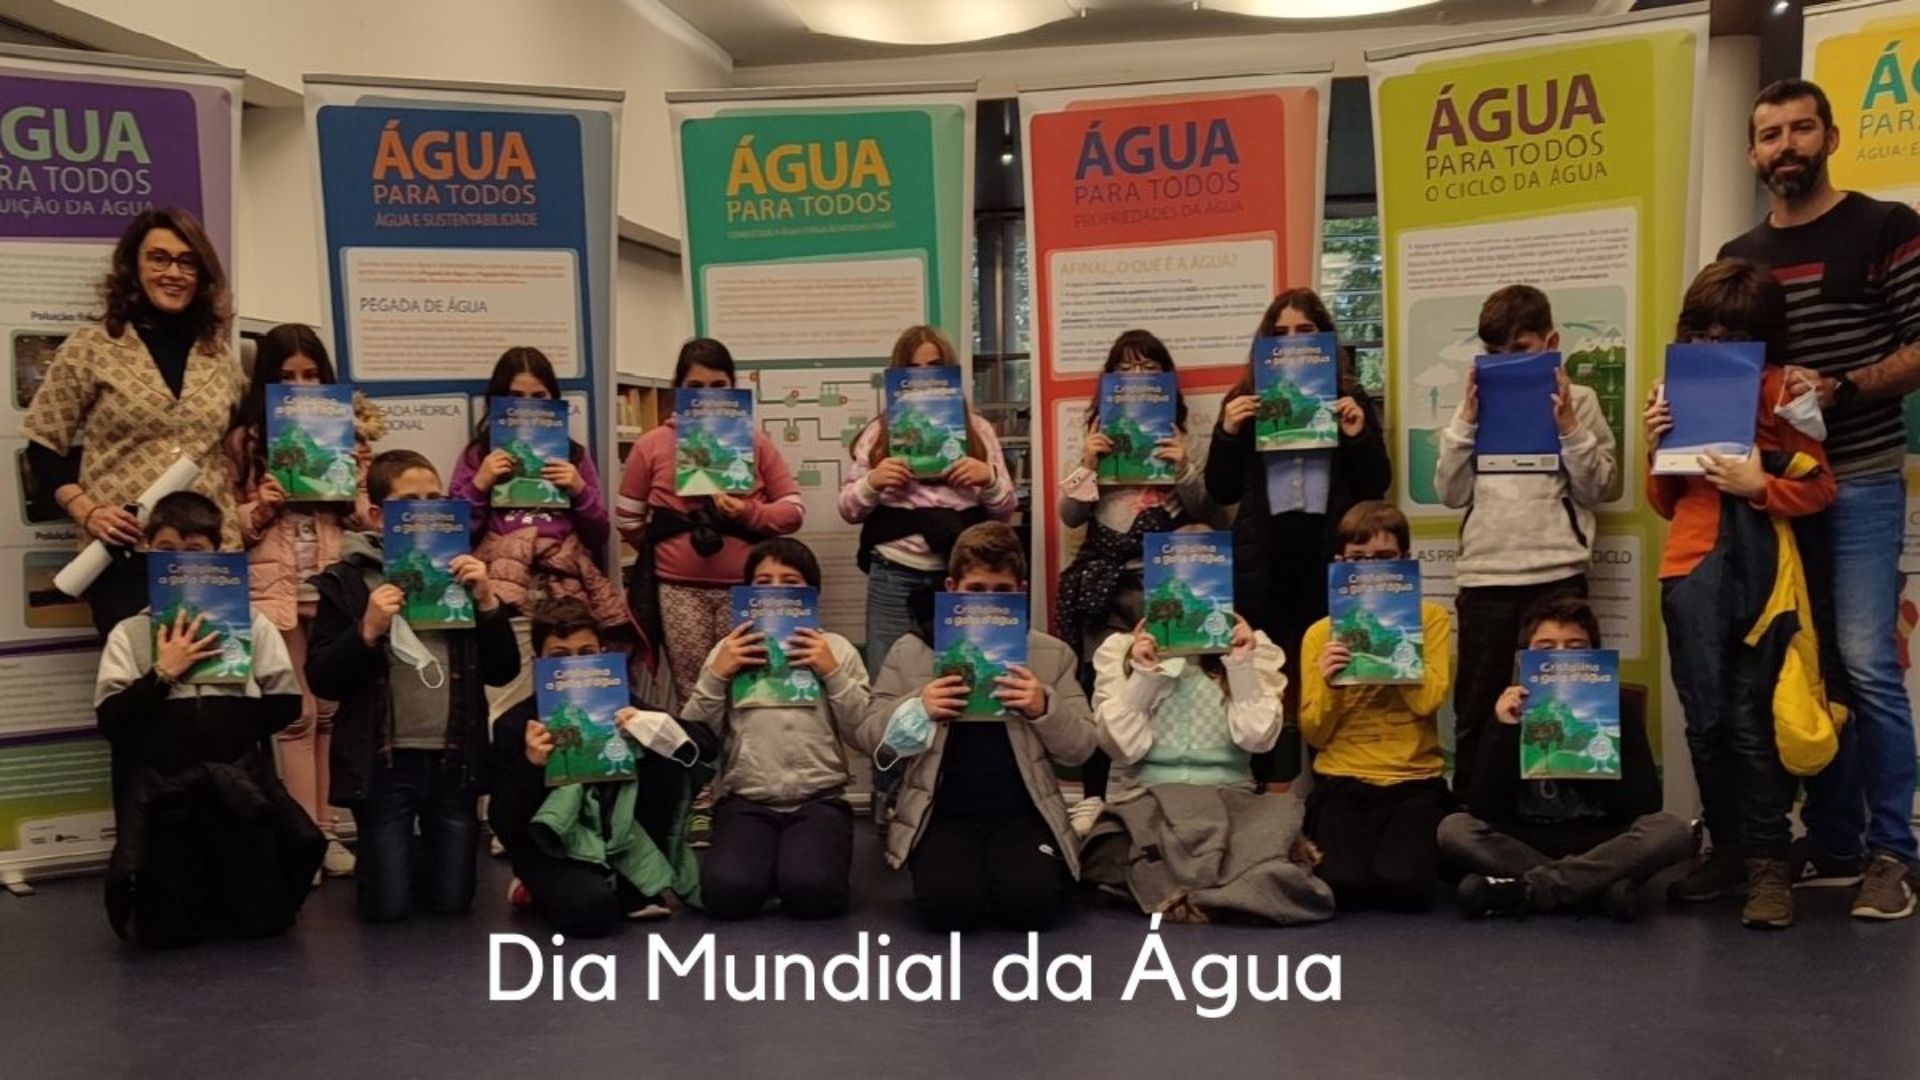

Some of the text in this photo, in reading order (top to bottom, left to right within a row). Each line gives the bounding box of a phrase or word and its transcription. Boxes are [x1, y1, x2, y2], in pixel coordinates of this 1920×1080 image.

[1425, 73, 1606, 151] ÁGUA
[1858, 109, 1920, 140] PAR
[0, 105, 151, 164] GUA
[372, 119, 537, 180] ÁGUA
[1075, 118, 1240, 180] ÁGUA
[725, 134, 892, 196] ÁGUA
[1426, 130, 1605, 180] PARA TODOS
[43, 166, 152, 195] TODOS
[374, 184, 537, 206] PARA TODOS
[1075, 170, 1241, 206] PARA TODOS
[1425, 160, 1608, 202] O CICLO DA ÁGUA
[65, 200, 96, 215] DA
[727, 191, 892, 222] PARA TODOS
[1075, 199, 1245, 228] PROPRIEDADES DA ÁGUA
[1131, 257, 1161, 273] QUE
[360, 296, 488, 313] PEGADA DE ÁGUA
